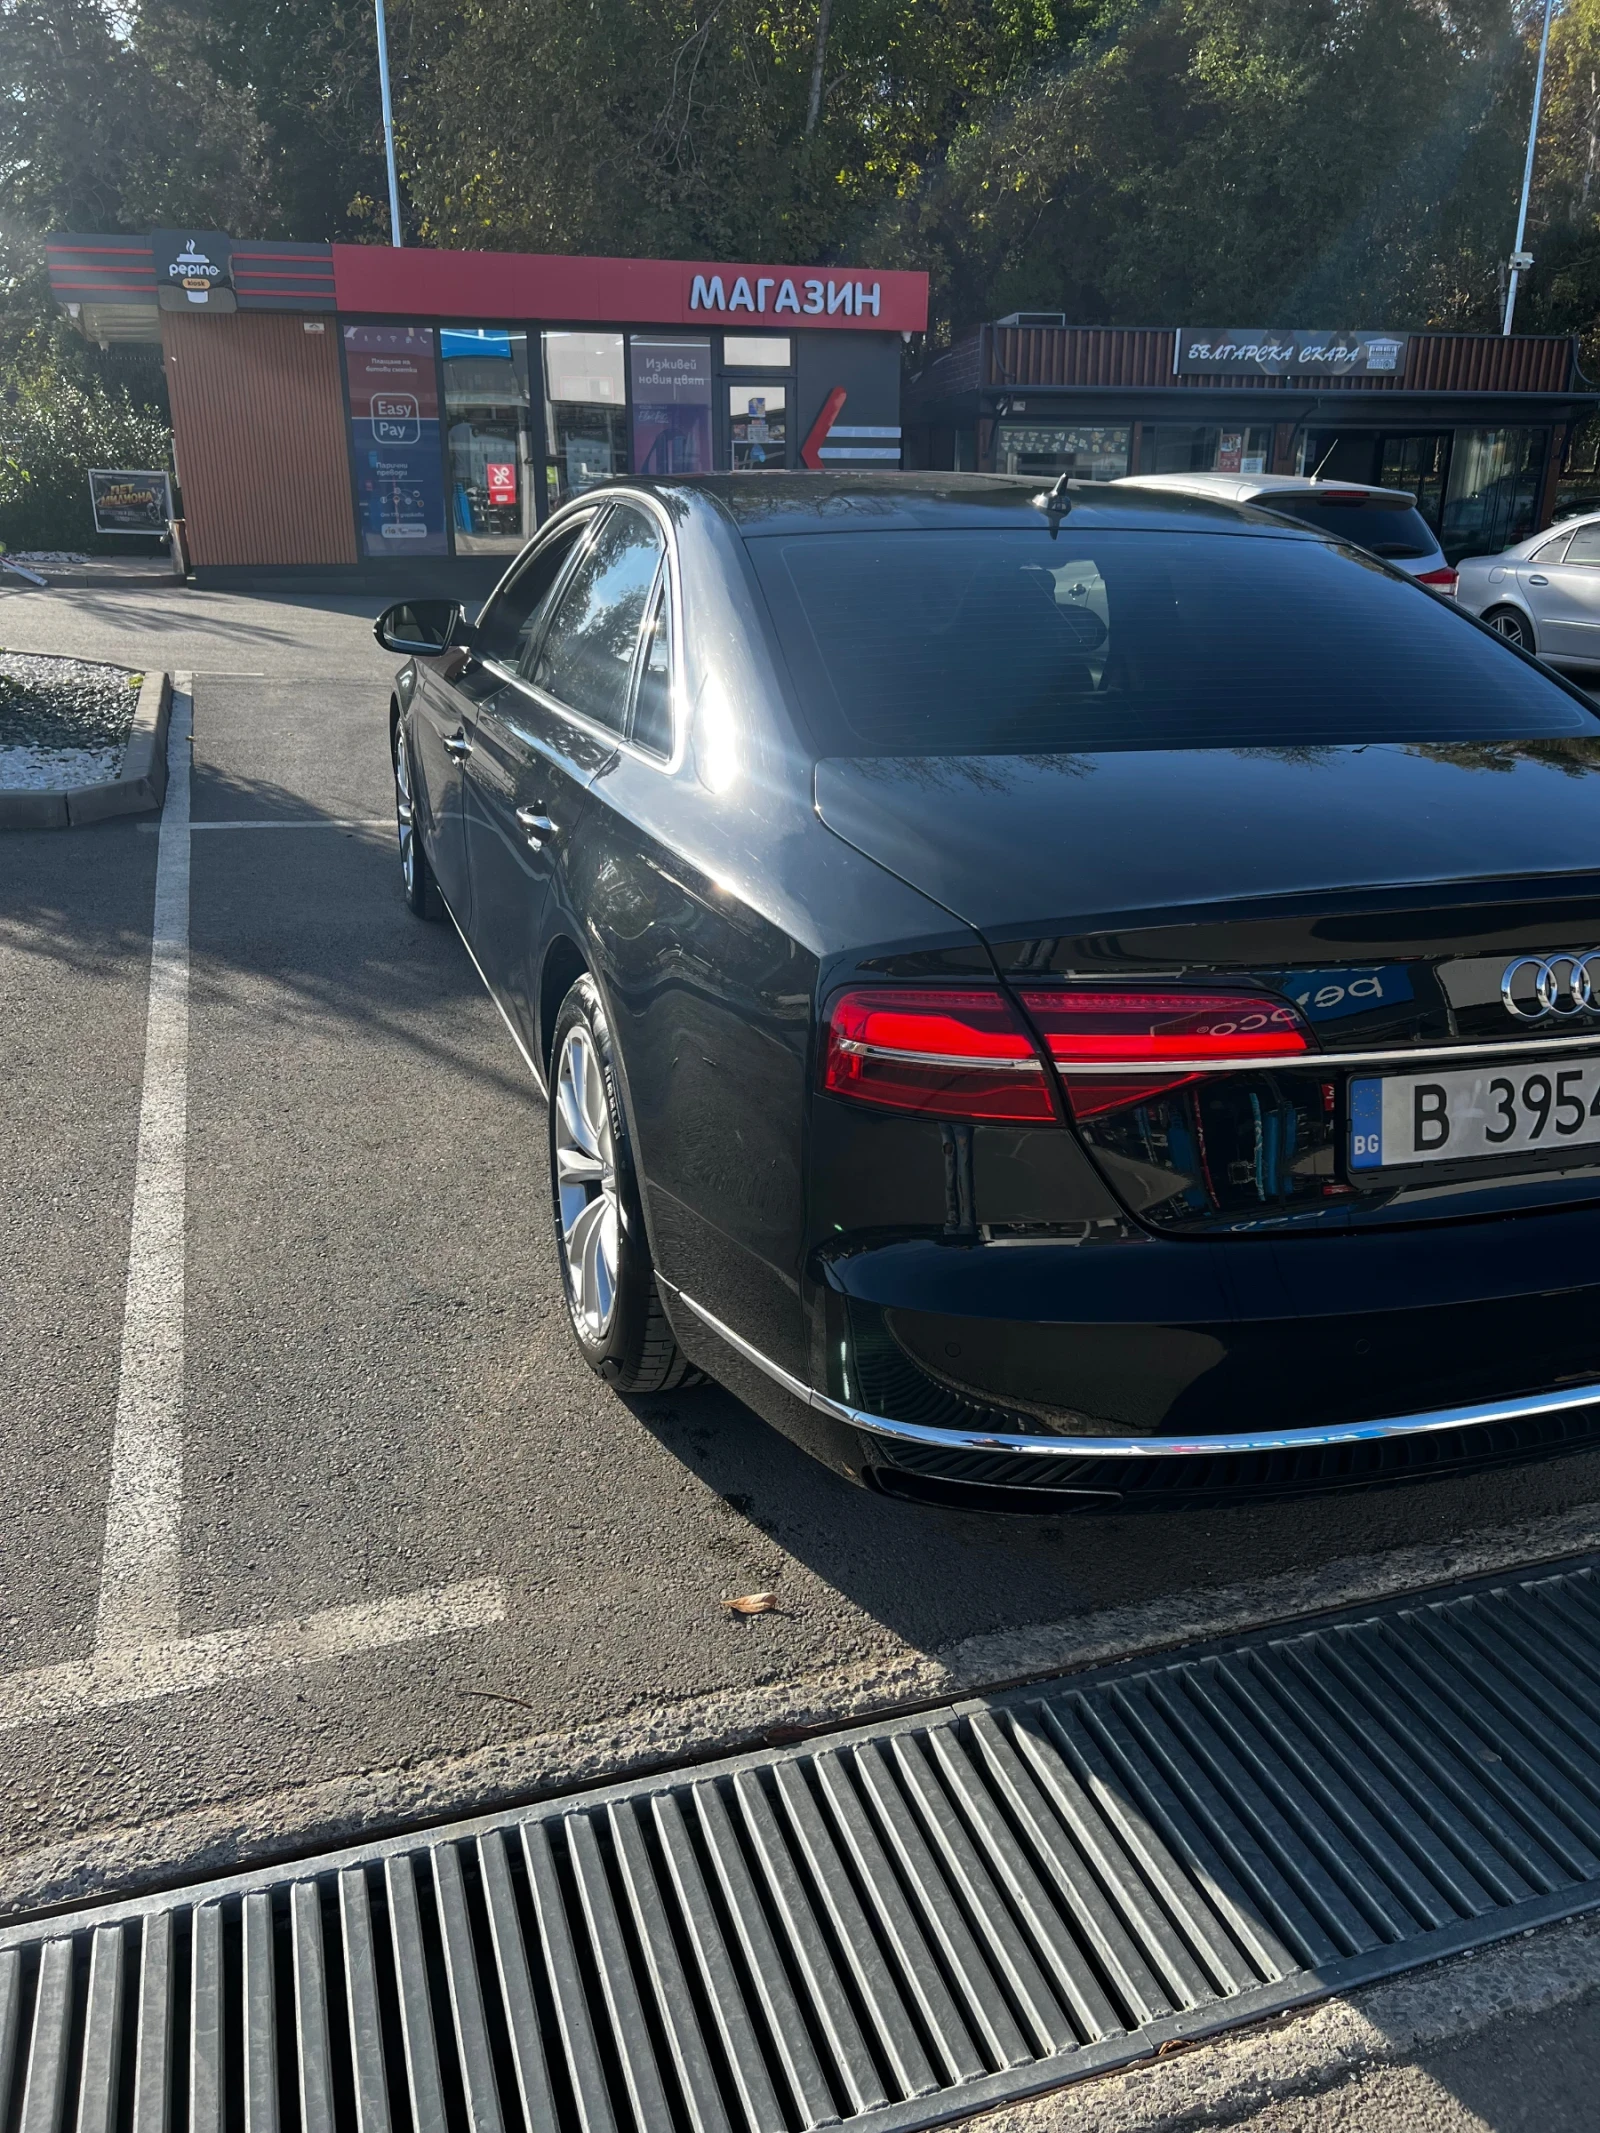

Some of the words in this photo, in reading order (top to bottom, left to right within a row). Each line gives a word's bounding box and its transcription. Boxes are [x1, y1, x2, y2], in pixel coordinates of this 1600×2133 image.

[169, 264, 220, 277] pepino
[690, 275, 880, 317] МАГАЗИН
[1188, 343, 1294, 363] БЪЛГАРСКА
[1298, 345, 1360, 364] СКАРА
[646, 358, 697, 372] Изживей
[638, 374, 672, 385] новия
[674, 374, 705, 386] цвят
[378, 401, 412, 417] Easy
[379, 421, 406, 438] Pay
[376, 461, 408, 470] Парични
[376, 469, 408, 478] преводи
[110, 483, 135, 495] ПЕТ
[101, 491, 153, 506] МИЛИОНА
[1414, 1084, 1450, 1152] B
[1353, 1134, 1379, 1155] BG
